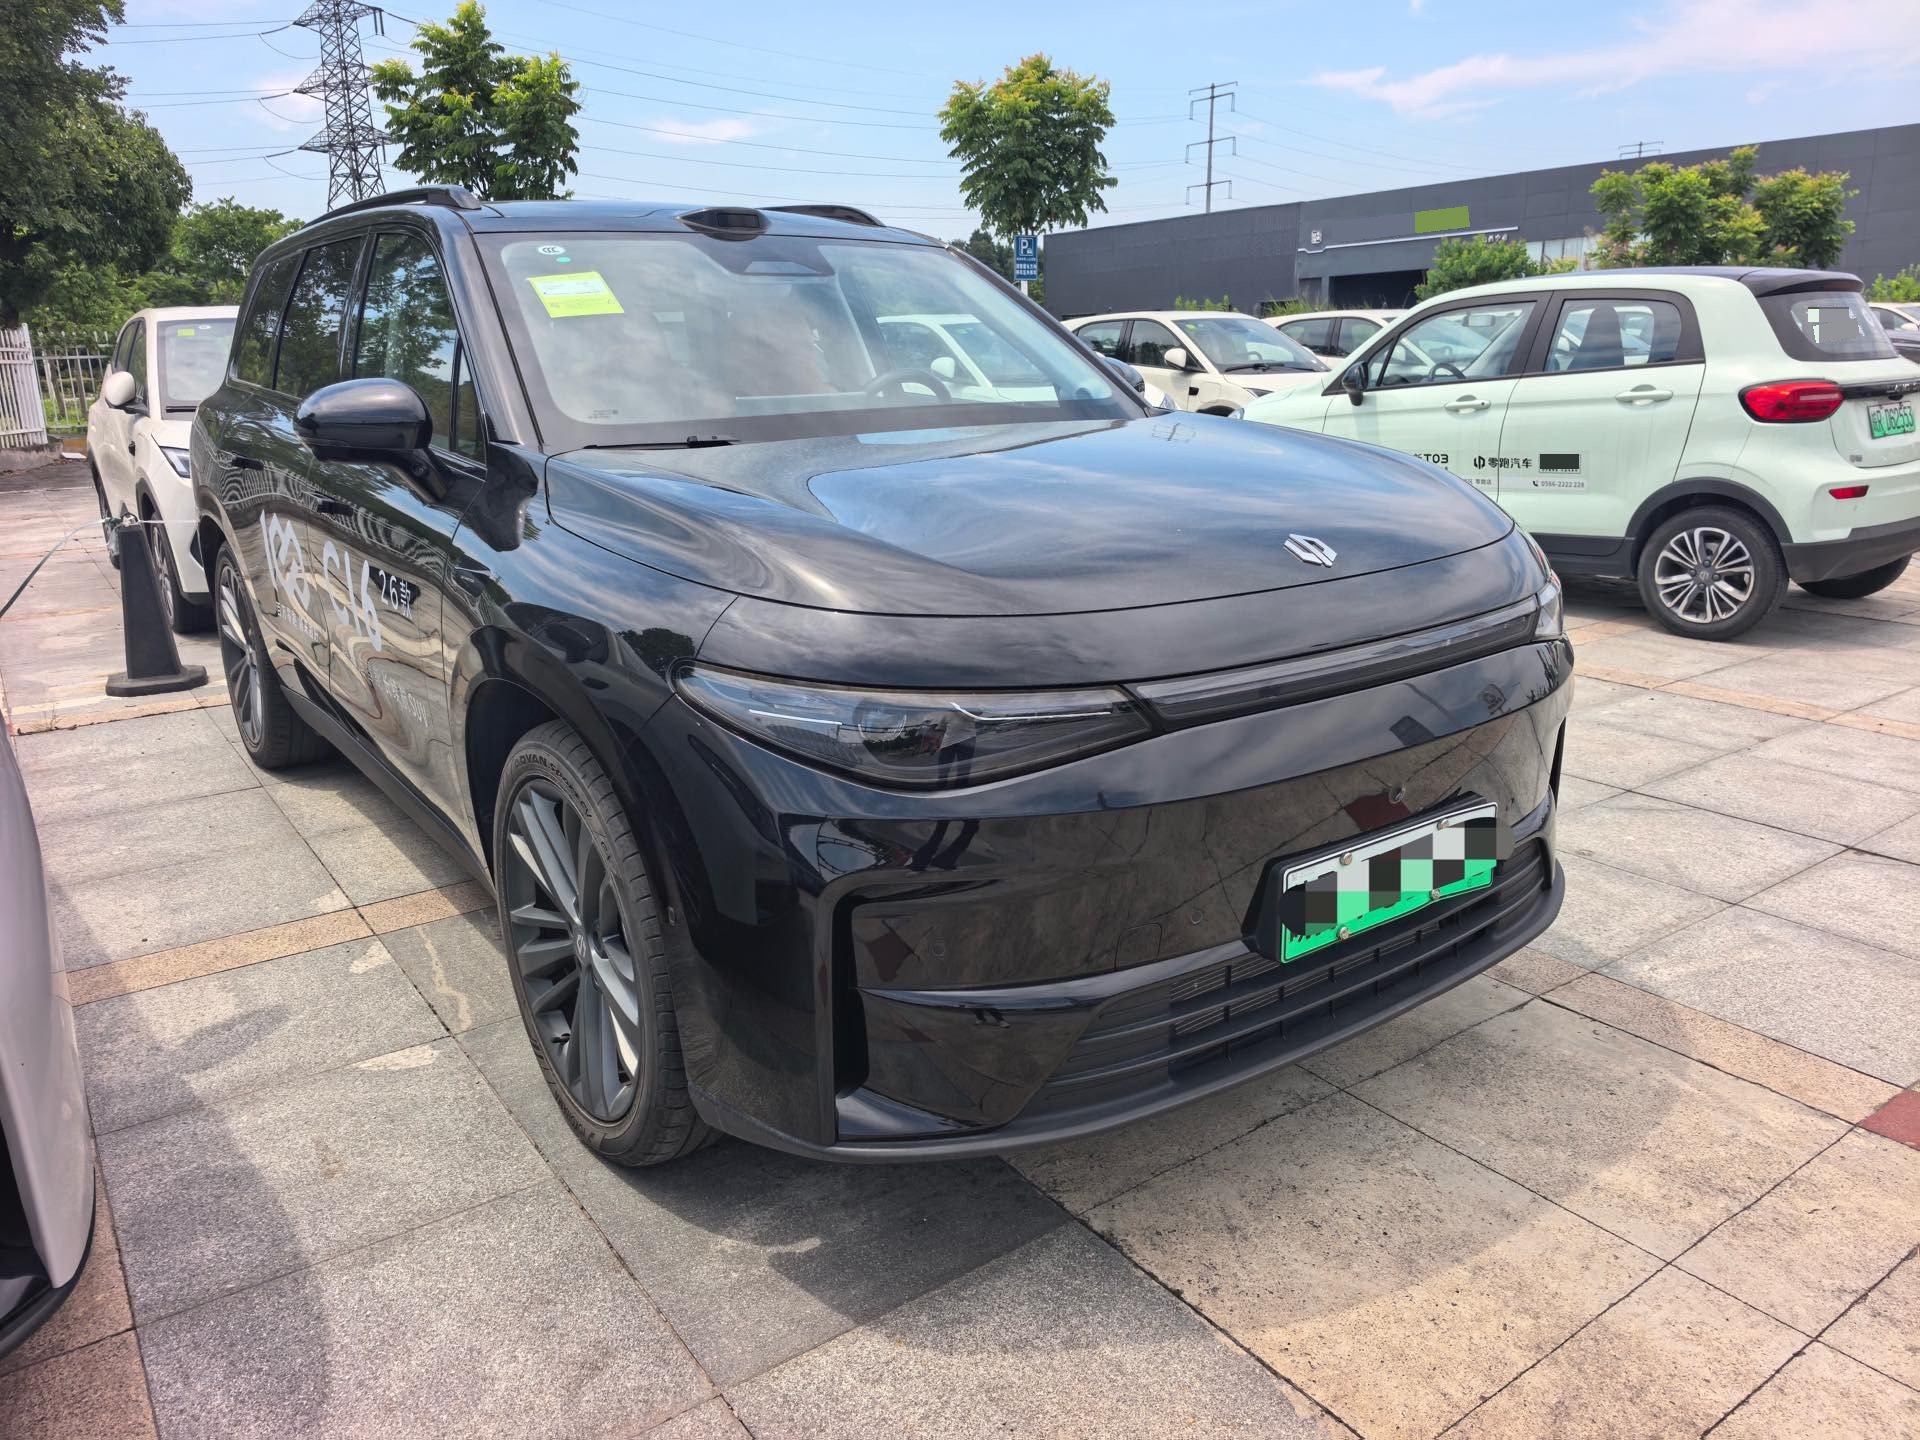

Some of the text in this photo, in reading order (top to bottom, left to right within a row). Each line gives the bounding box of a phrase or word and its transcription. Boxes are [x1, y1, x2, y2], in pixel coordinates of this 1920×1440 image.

[1020, 239, 1029, 255] P
[1487, 457, 1533, 469] 零跑汽车
[378, 569, 413, 620] 26款
[514, 753, 548, 768] ADVAN
